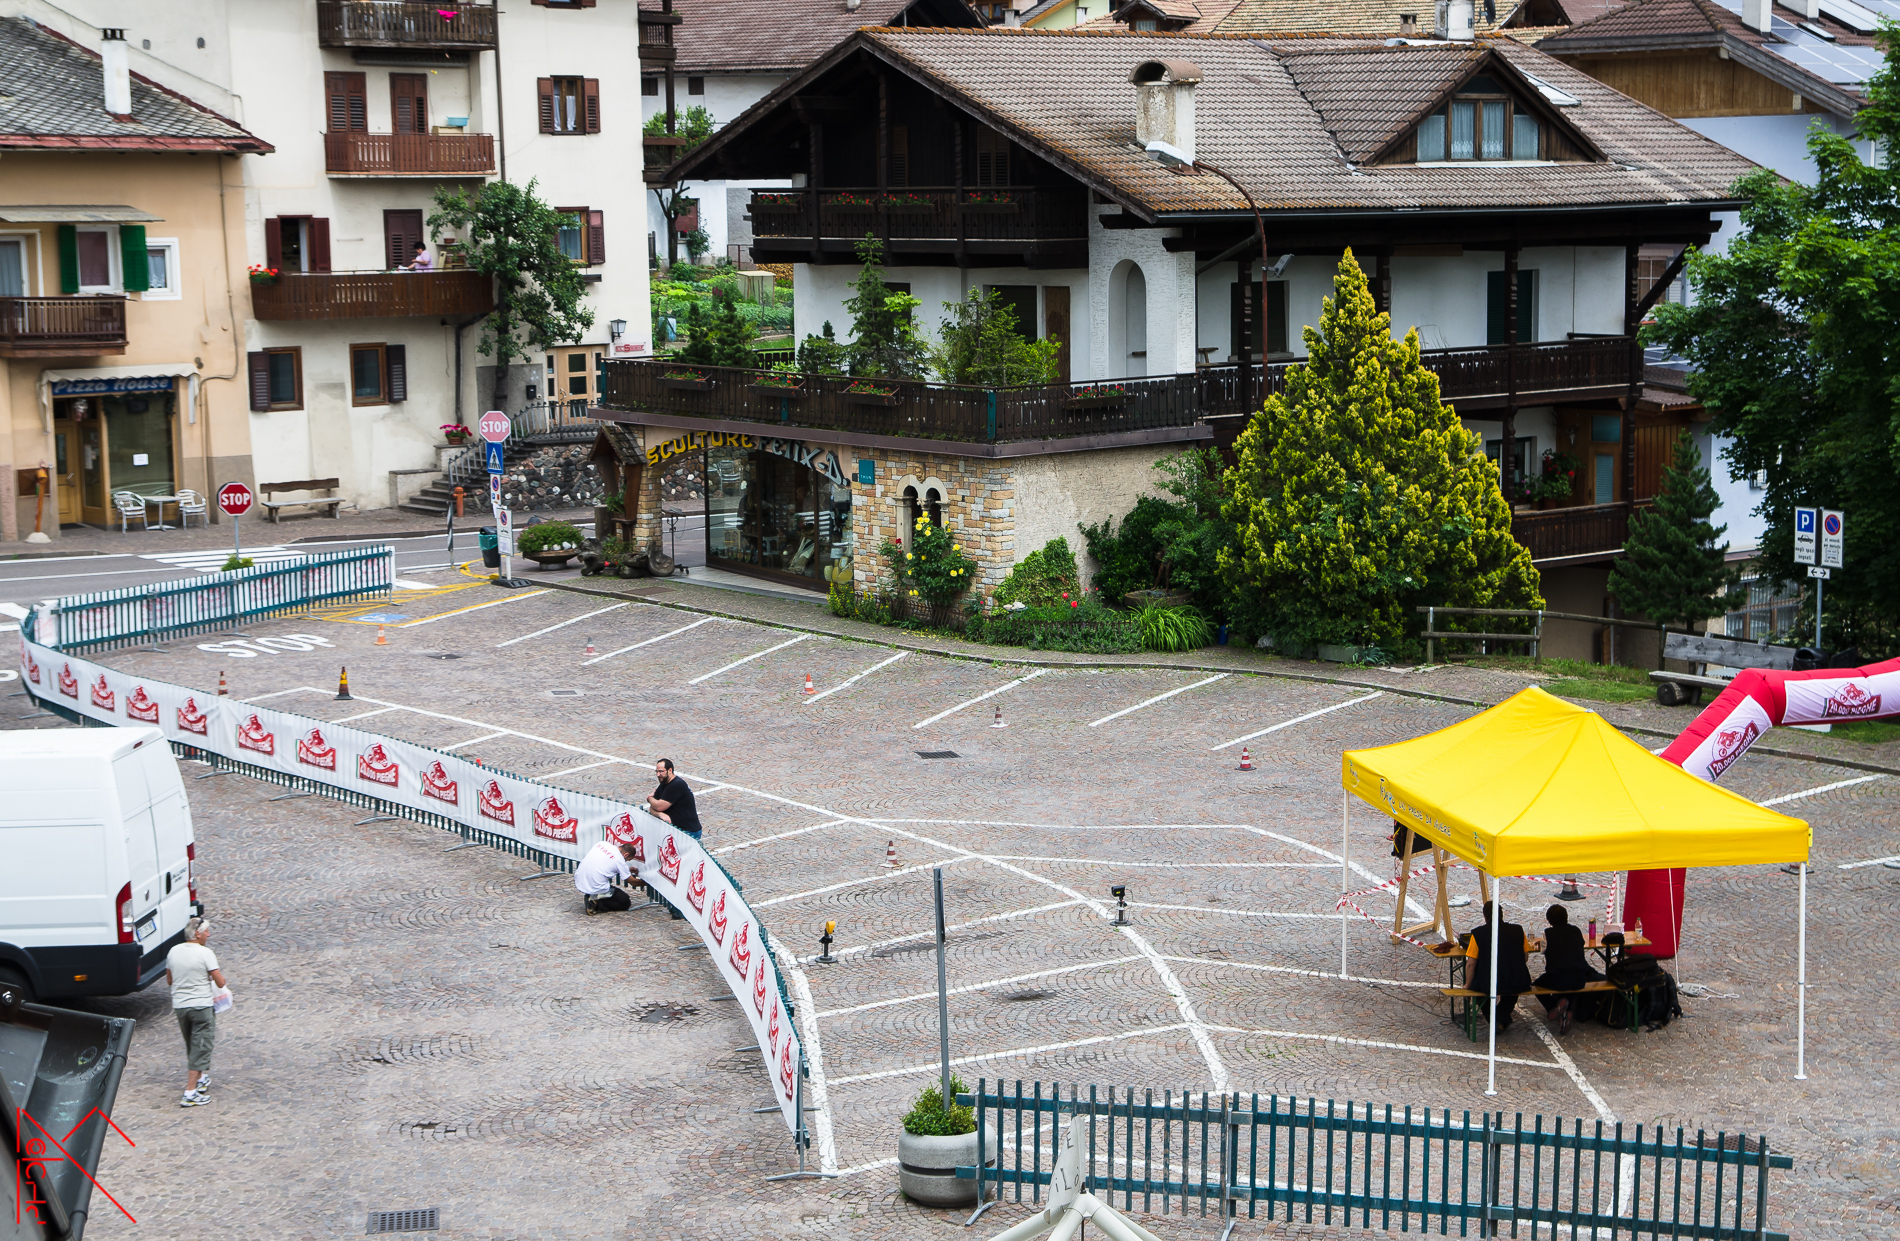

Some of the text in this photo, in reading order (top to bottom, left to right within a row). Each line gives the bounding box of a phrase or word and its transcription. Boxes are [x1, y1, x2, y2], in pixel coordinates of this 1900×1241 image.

[54, 378, 170, 394] Pizza House
[482, 420, 509, 433] STOP
[646, 430, 754, 468] SCULTURE
[221, 492, 251, 506] STOP
[1802, 514, 1810, 529] P
[196, 633, 336, 659] STOP
[1713, 726, 1756, 774] 20.000 PIEGHE
[596, 843, 615, 859] STAFF
